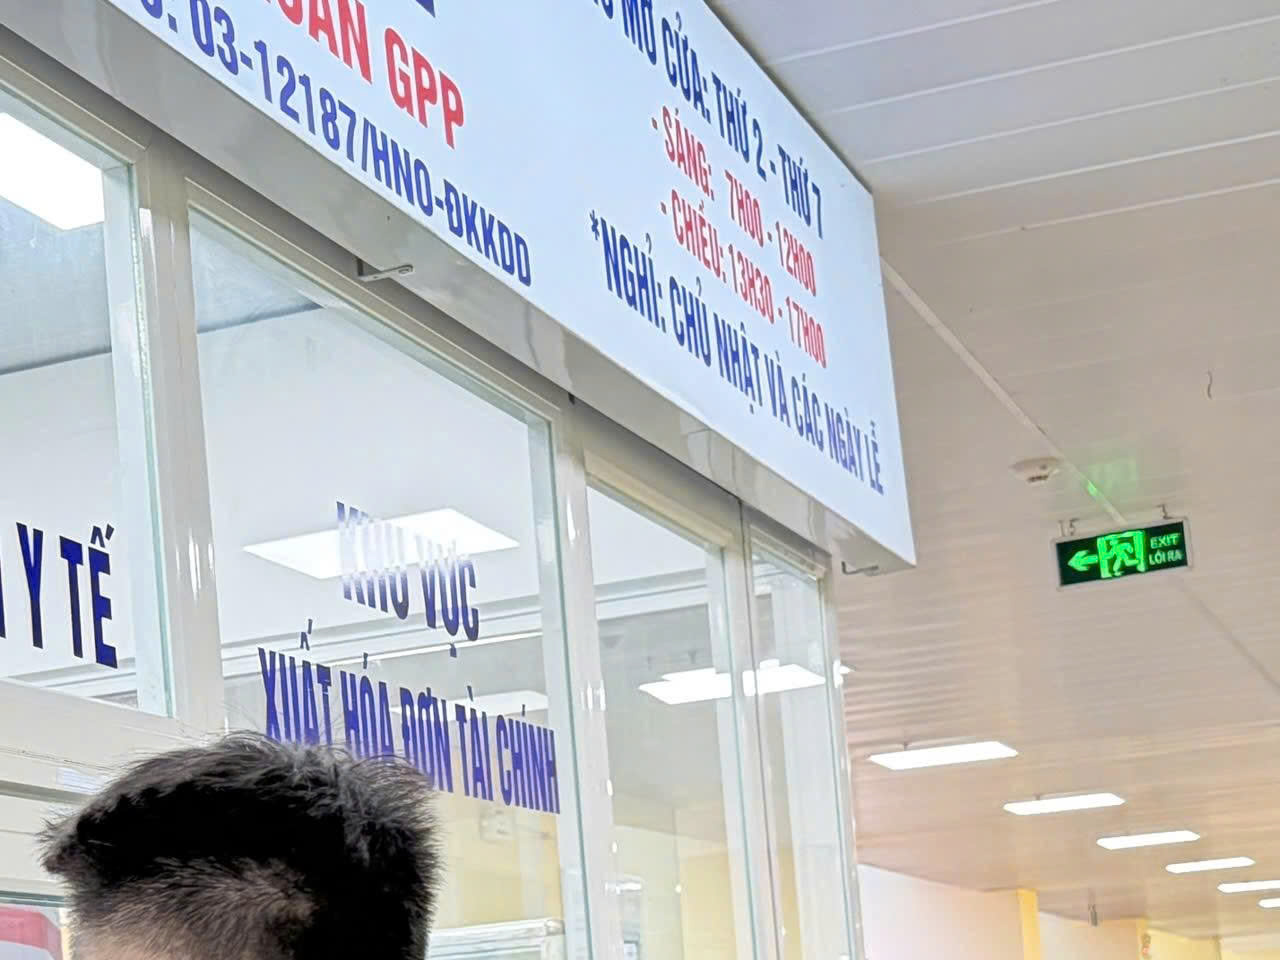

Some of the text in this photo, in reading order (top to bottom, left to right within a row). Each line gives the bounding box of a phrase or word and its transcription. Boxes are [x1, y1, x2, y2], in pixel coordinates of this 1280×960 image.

[384, 27, 464, 150] GPP
[661, 11, 711, 124] CỬA:
[711, 71, 749, 163] THỨ
[752, 118, 766, 181] 2
[777, 144, 811, 226] THỨ
[811, 182, 823, 240] 7
[661, 105, 714, 201] SÁNG:
[724, 169, 764, 248] 7H00
[775, 221, 816, 297] 12H00
[671, 189, 727, 284] CHIỀU:
[728, 244, 774, 325] 13H30
[786, 296, 826, 369] 17H00
[670, 276, 712, 367] CHỦ
[713, 312, 762, 414] NHẬT
[764, 350, 791, 427] VÀ
[791, 373, 824, 452] CÁC
[824, 403, 864, 482] NGÀY
[16, 522, 44, 649] Y
[60, 523, 119, 669] TẾ
[1150, 533, 1181, 549] EXIT
[1169, 550, 1183, 562] RA
[400, 687, 454, 792] ĐƠN
[455, 685, 494, 801] TÀI
[496, 704, 561, 815] CHÍNH
